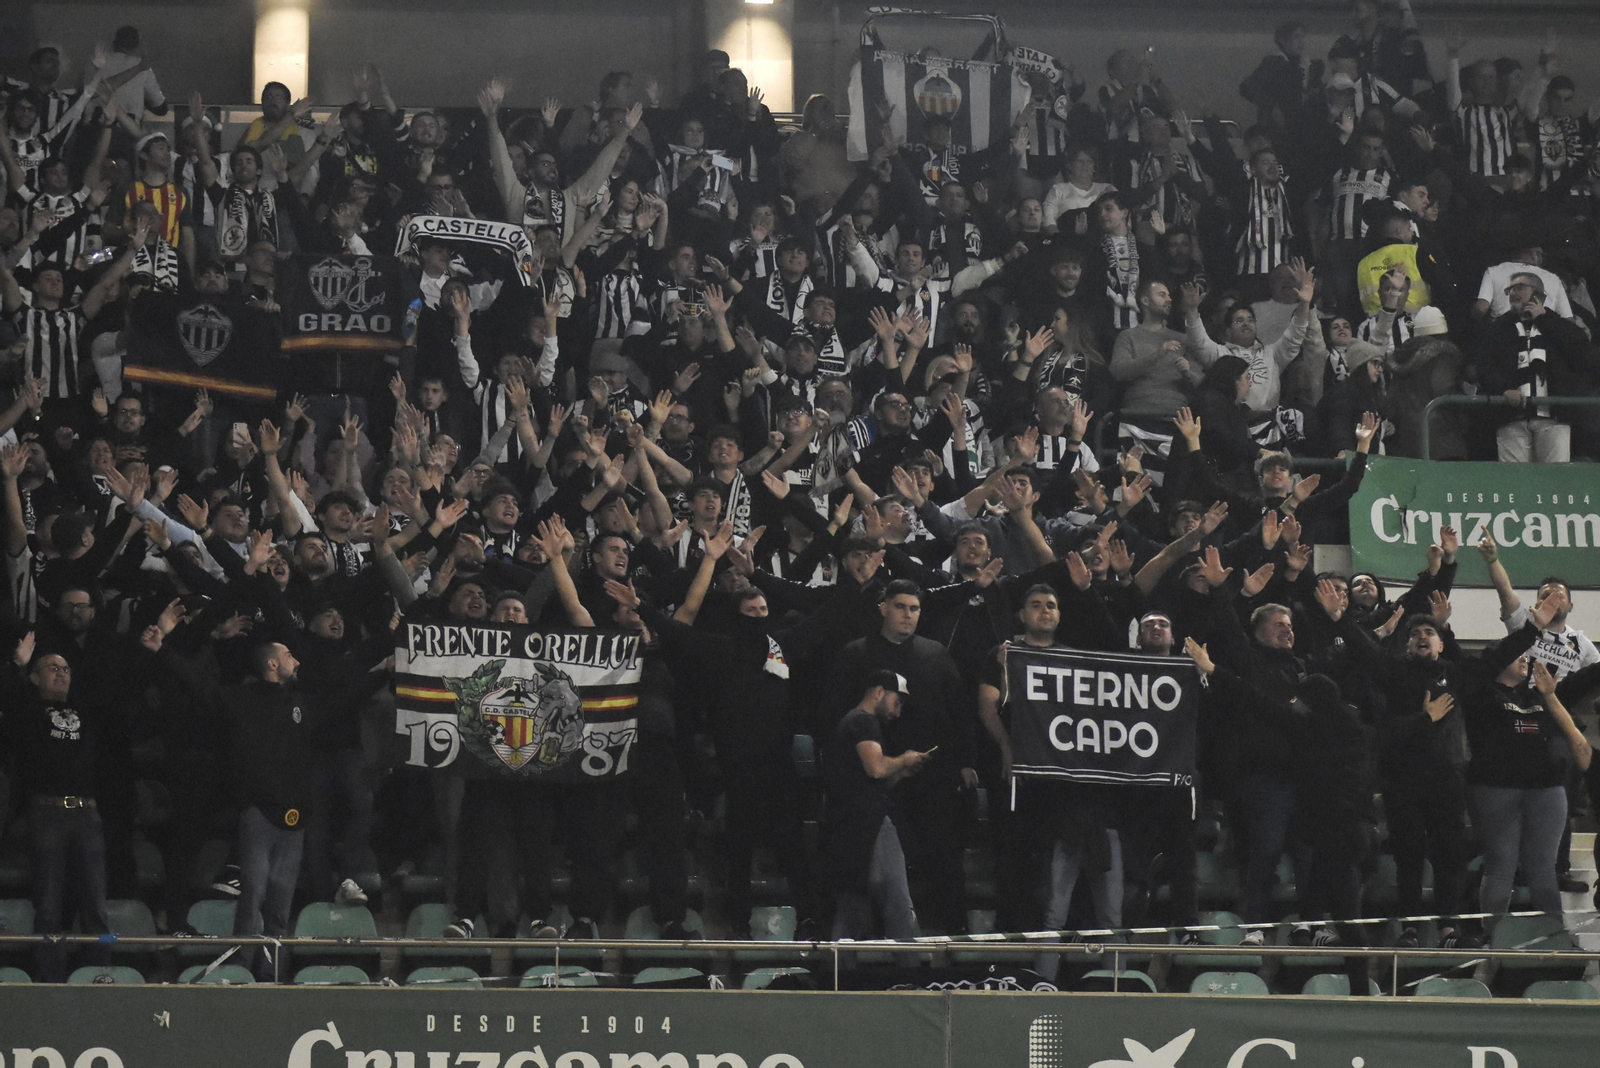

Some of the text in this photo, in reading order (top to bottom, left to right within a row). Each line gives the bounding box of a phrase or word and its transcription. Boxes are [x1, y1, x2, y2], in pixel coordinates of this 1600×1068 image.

[423, 219, 529, 252] CASTELLÓN
[298, 313, 392, 333] GRAO
[1447, 492, 1590, 505] DESDE 1904
[406, 623, 512, 664] FRENTE
[1537, 640, 1578, 662] ECHLAM
[1026, 665, 1182, 711] ETERNO
[503, 708, 530, 718] CASTEL
[1049, 714, 1159, 758] CAPO
[426, 1014, 671, 1034] DESDE 1904
